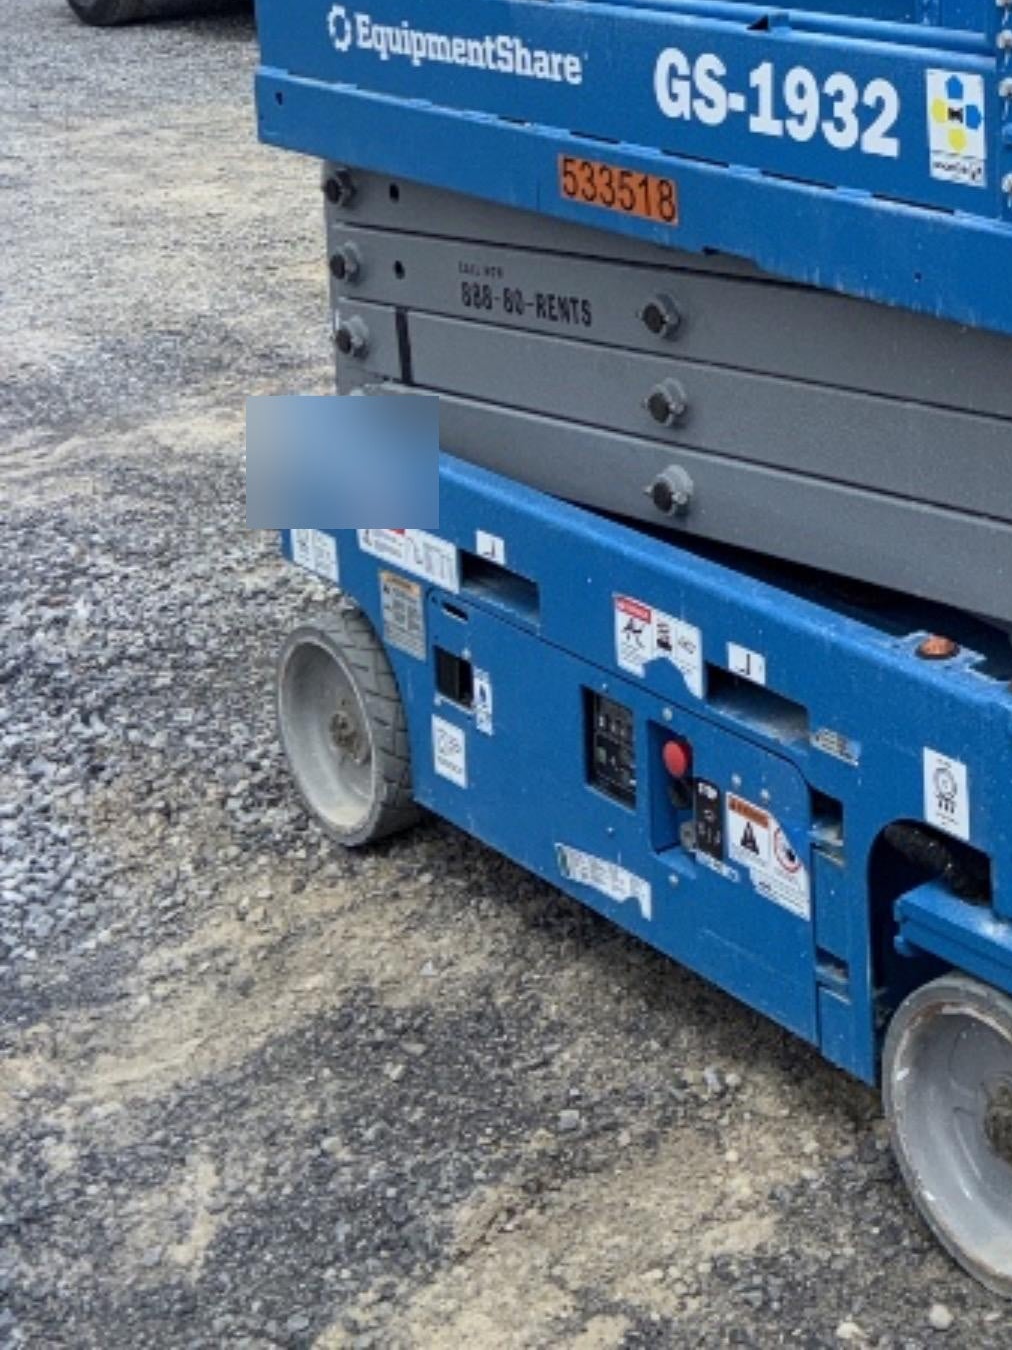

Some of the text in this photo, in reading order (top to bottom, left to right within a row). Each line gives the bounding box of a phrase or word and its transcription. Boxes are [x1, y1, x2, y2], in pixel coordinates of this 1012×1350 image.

[353, 12, 584, 85] EquipmentShare
[654, 47, 899, 157] GS-1932
[562, 157, 677, 222] 533518
